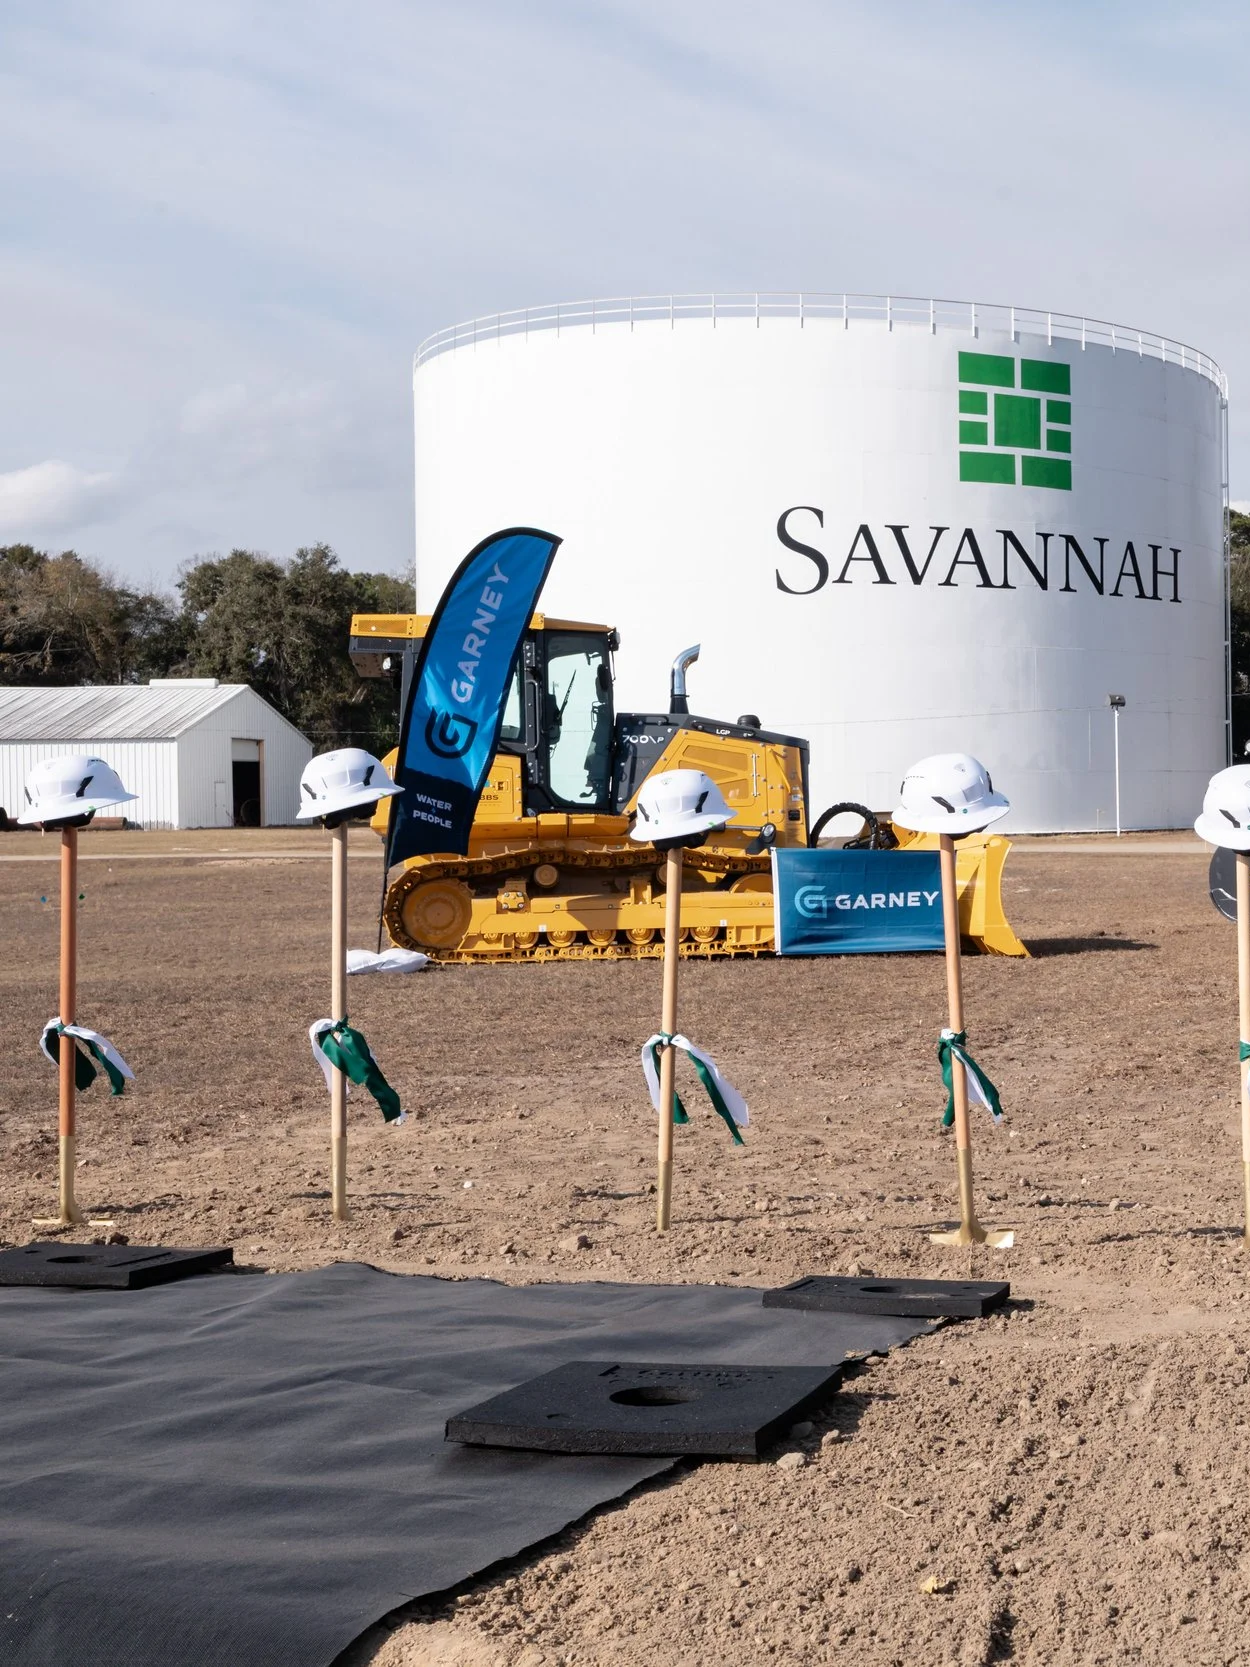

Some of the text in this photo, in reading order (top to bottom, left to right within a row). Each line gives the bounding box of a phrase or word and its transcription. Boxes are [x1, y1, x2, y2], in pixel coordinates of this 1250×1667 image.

[775, 506, 1182, 603] SAVANNAH
[451, 562, 509, 704] GARNEY
[716, 728, 731, 736] LGP
[416, 793, 453, 812] WATER
[412, 809, 453, 829] PEOPLE
[834, 891, 940, 910] GARNEY
